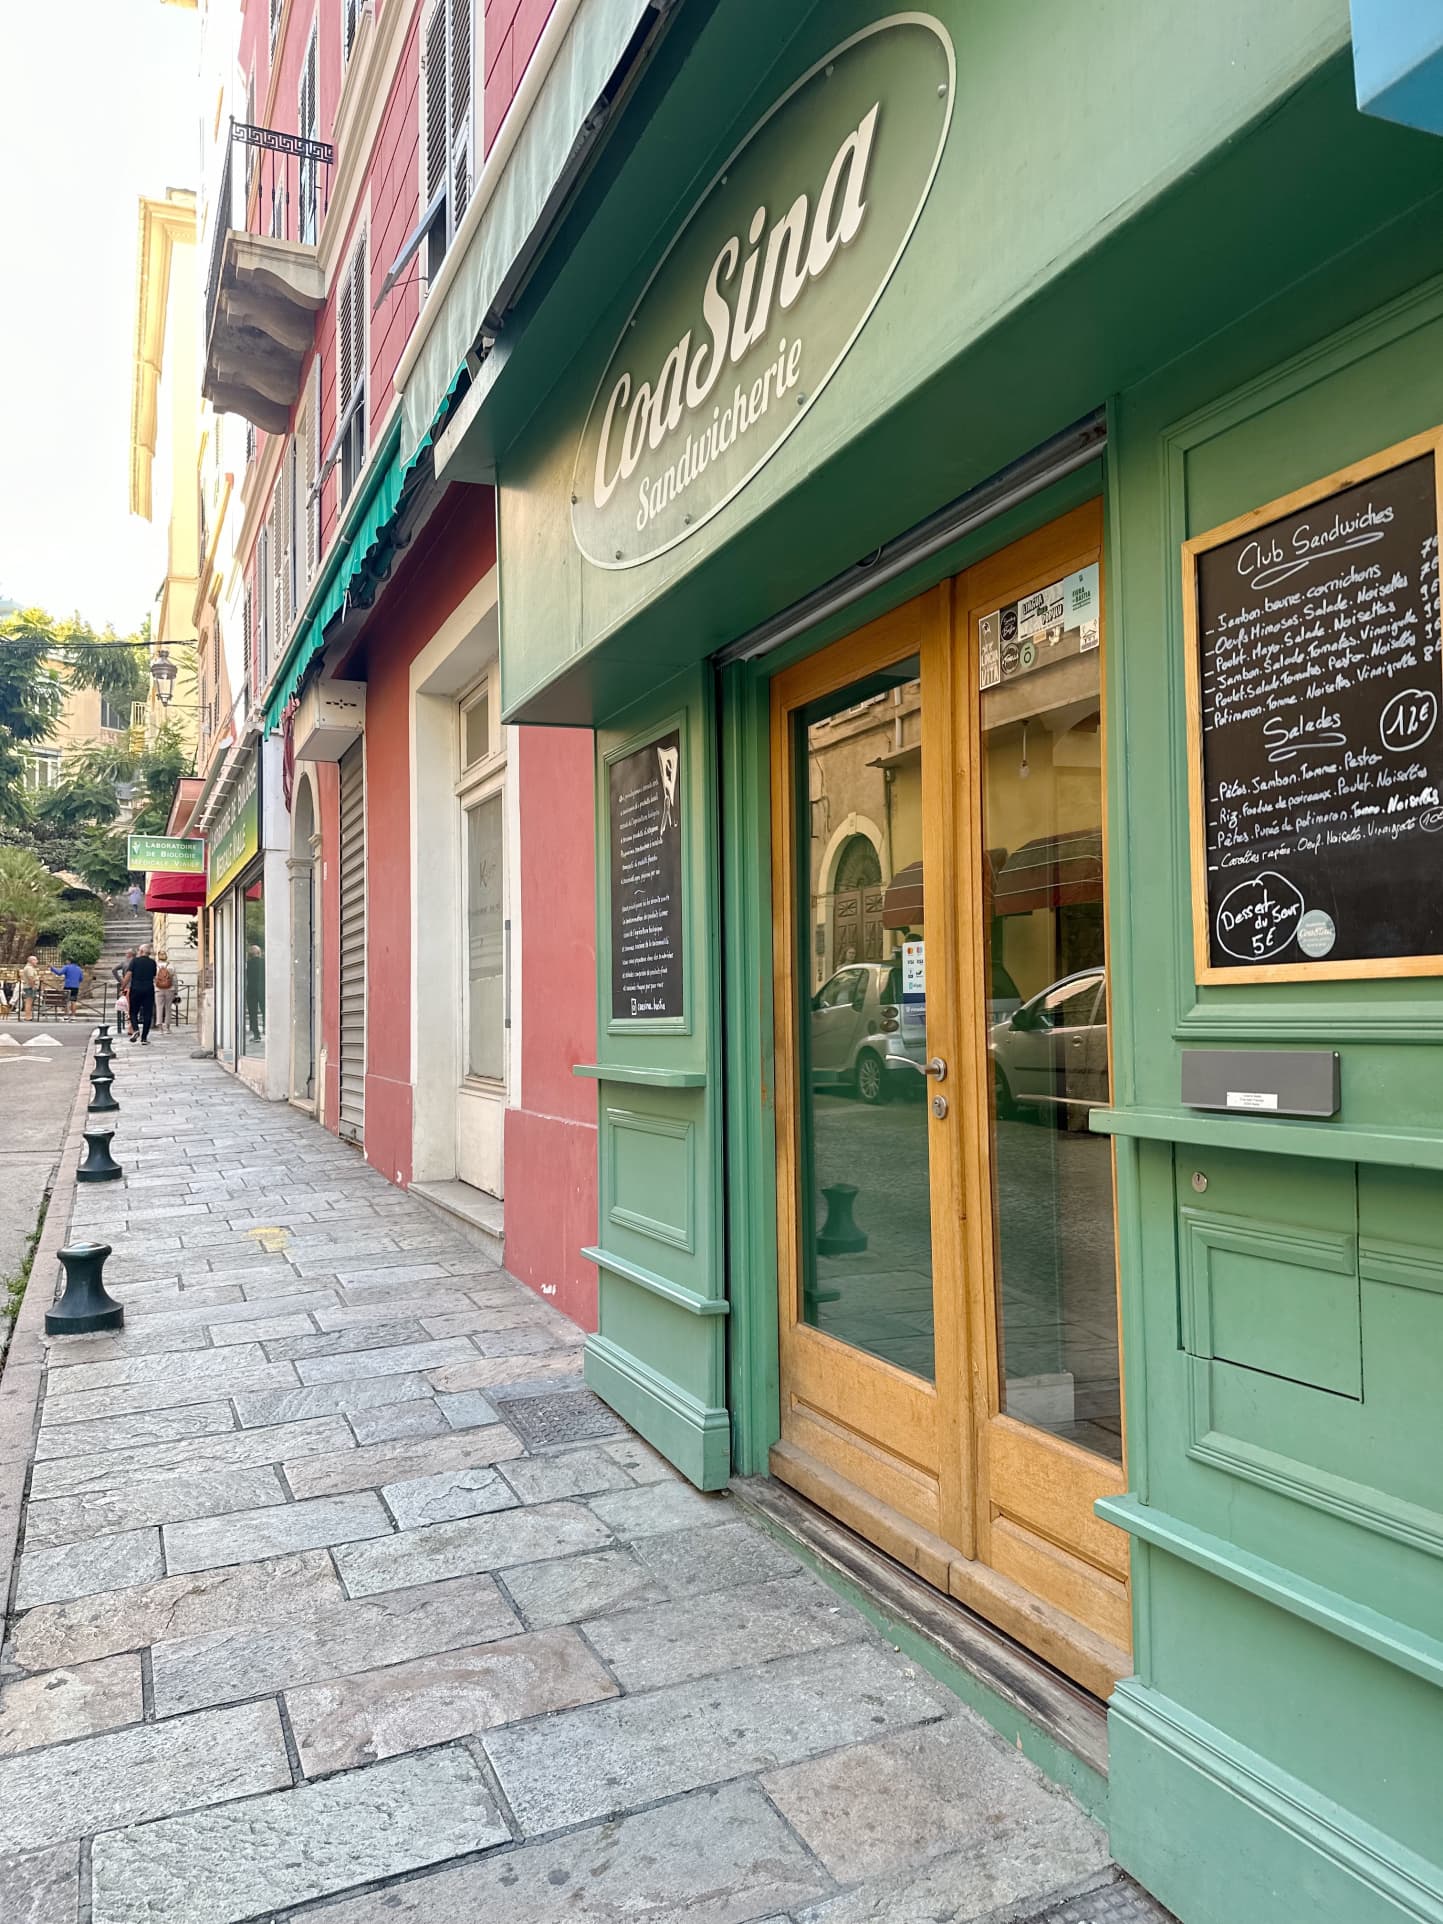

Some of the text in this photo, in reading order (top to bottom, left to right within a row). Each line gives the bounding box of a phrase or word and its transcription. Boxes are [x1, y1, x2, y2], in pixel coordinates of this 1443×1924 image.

[593, 101, 880, 510] CoaSina
[636, 338, 802, 531] Sandwicherie
[1237, 502, 1395, 576] Club Sandwiches
[1263, 706, 1341, 748] Salades
[1386, 702, 1430, 736] 12€
[1344, 745, 1382, 771] Pesto
[145, 841, 197, 850] LABORATOIRE
[1221, 888, 1276, 932] Dessert
[1254, 915, 1268, 930] du
[1251, 926, 1277, 954] 5€
